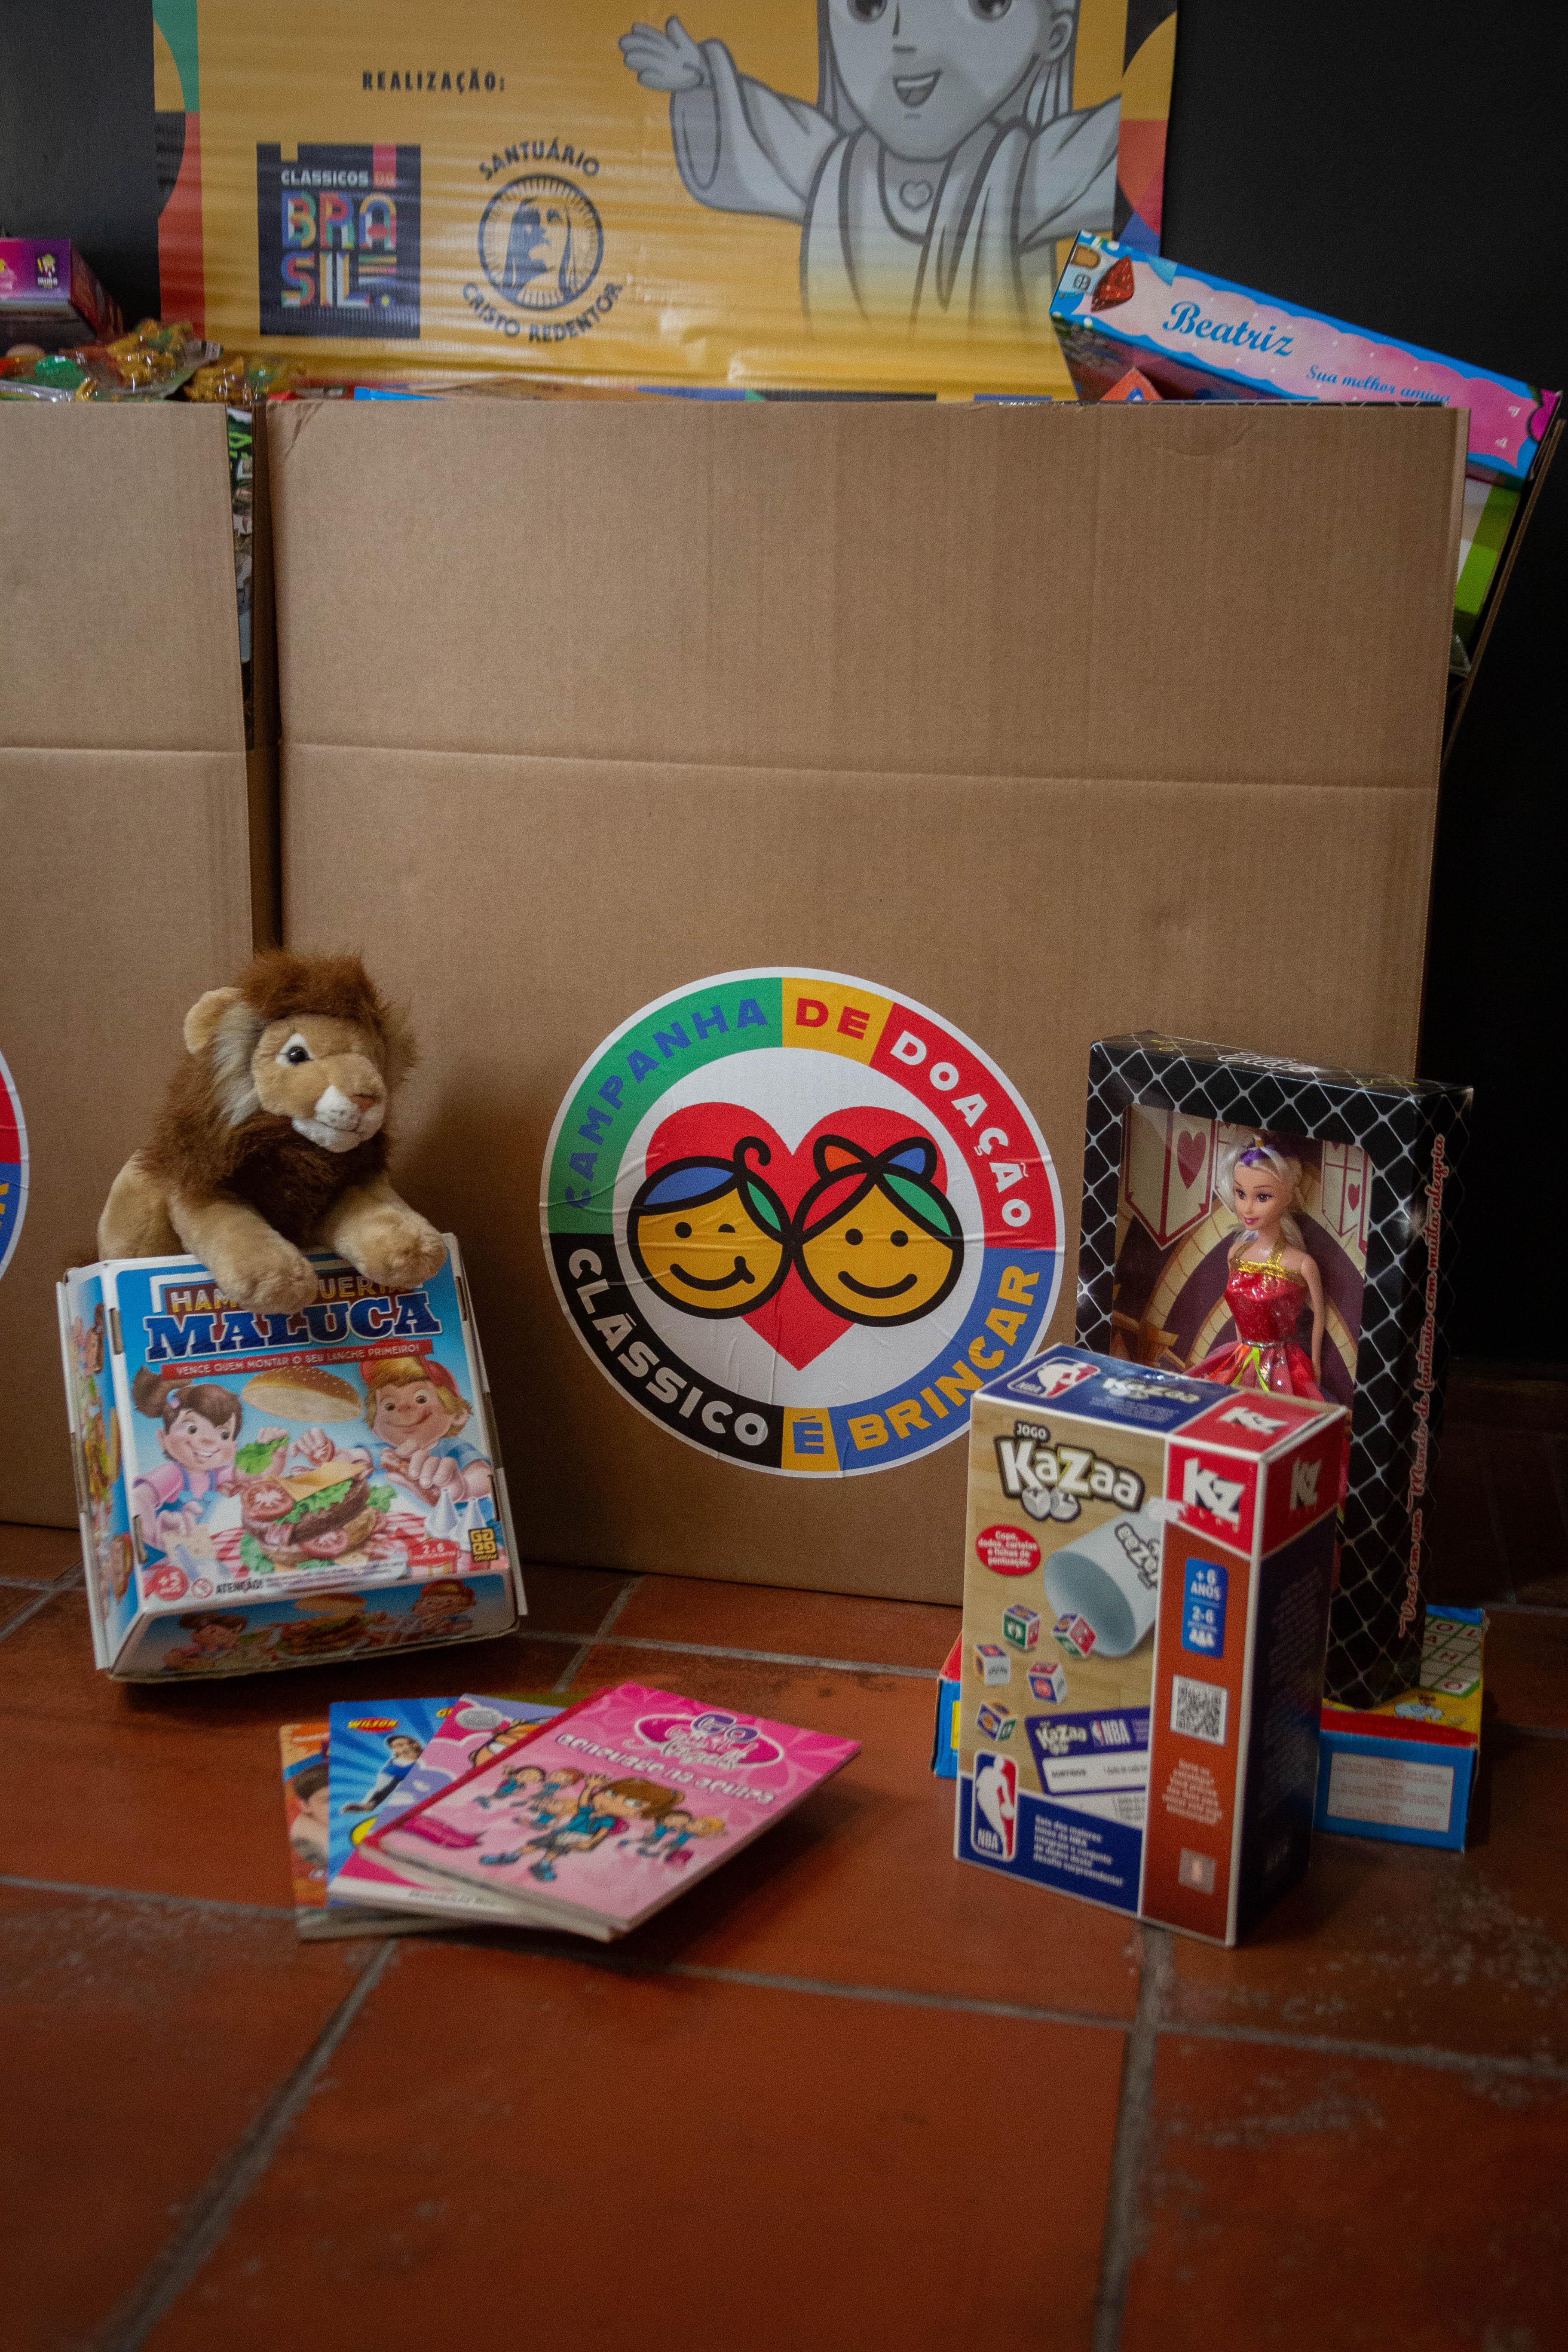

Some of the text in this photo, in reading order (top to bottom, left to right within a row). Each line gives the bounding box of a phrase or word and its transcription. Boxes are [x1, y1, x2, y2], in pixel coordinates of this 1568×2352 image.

[362, 67, 505, 93] REALIZAÇÃO:
[479, 138, 600, 181] SANTUÁRIO
[463, 282, 622, 343] CRISTO REDENTOR
[1163, 301, 1294, 356] Beatriz
[1341, 375, 1396, 395] melhor
[564, 997, 1031, 1227] CAMPANHA DE DOAÇÃO
[142, 1291, 443, 1363] MALUCA
[292, 1355, 301, 1364] O
[569, 1248, 1040, 1455] CLÁSSICO É BRINCAR
[1016, 1423, 1047, 1440] JOGO
[977, 1827, 999, 1851] NBA
